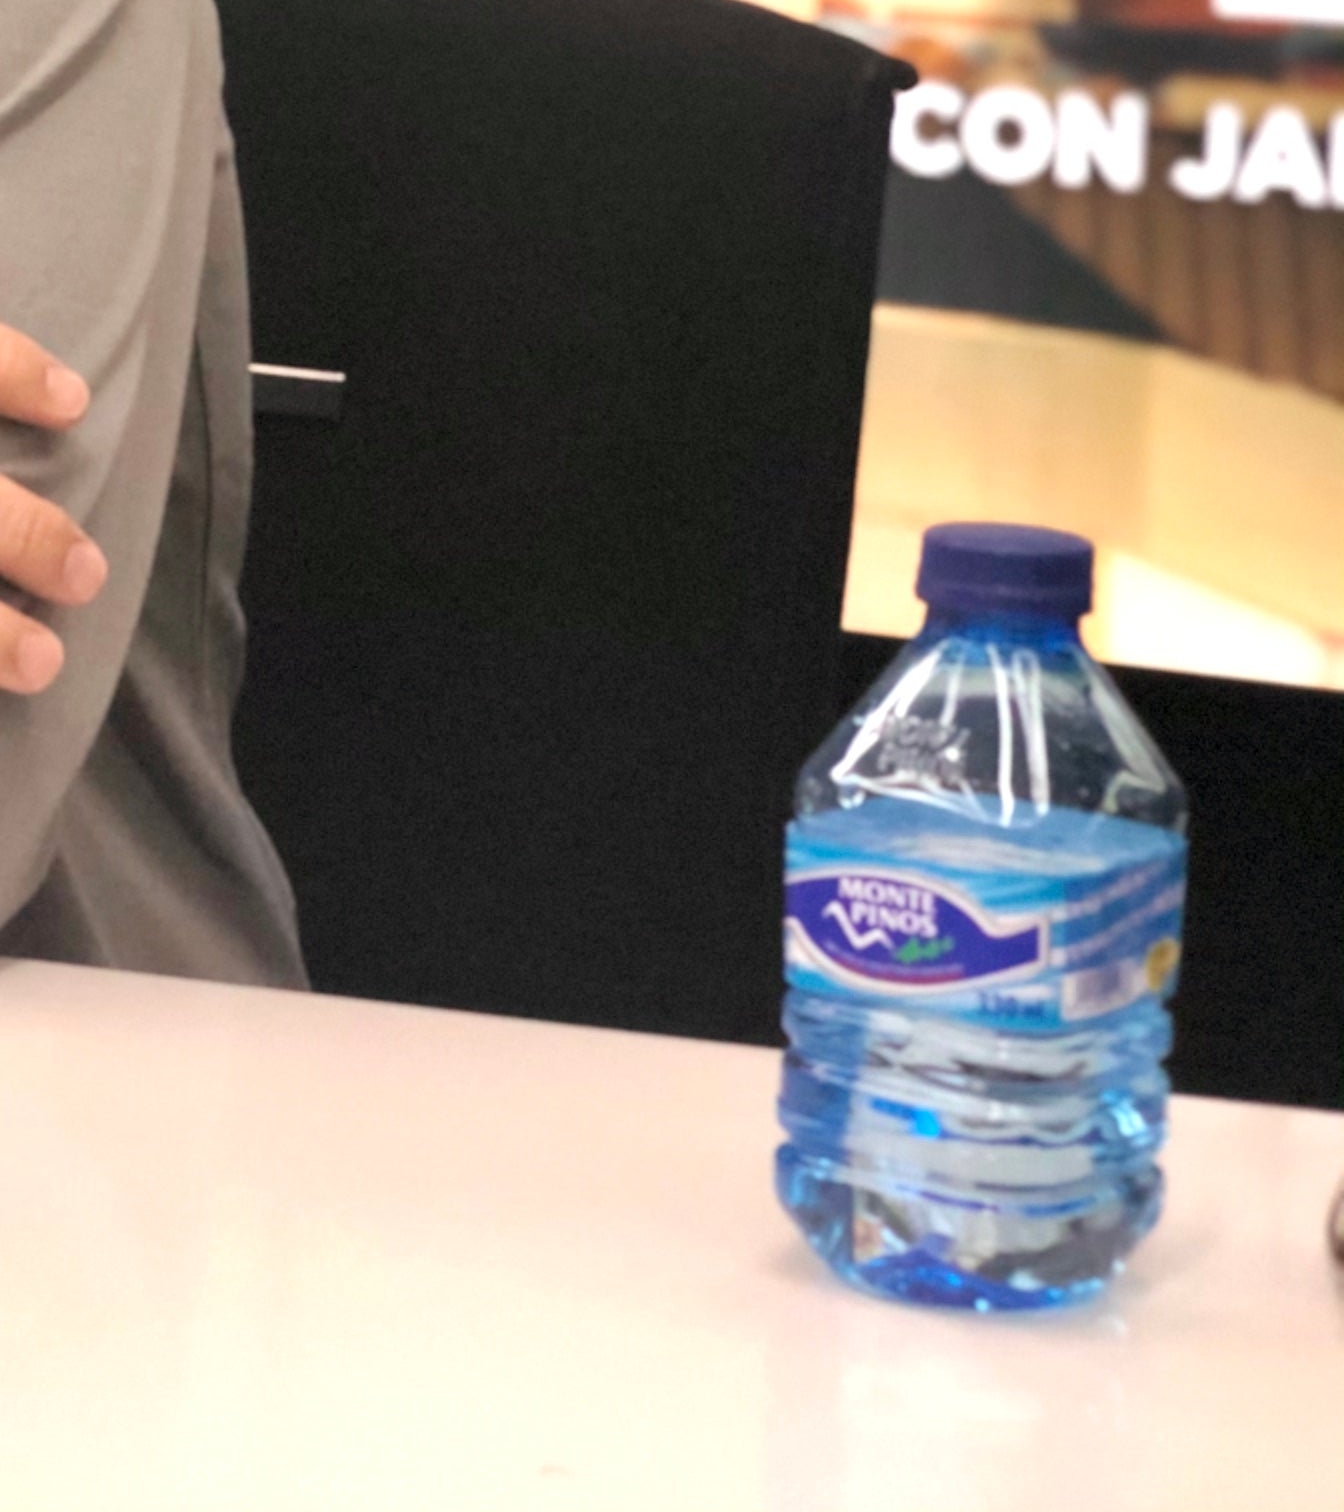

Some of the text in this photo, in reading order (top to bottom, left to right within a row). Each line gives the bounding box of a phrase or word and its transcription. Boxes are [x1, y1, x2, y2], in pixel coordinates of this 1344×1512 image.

[890, 80, 1149, 192] CON
[838, 876, 936, 914] MONTE
[850, 901, 939, 938] PINOS
